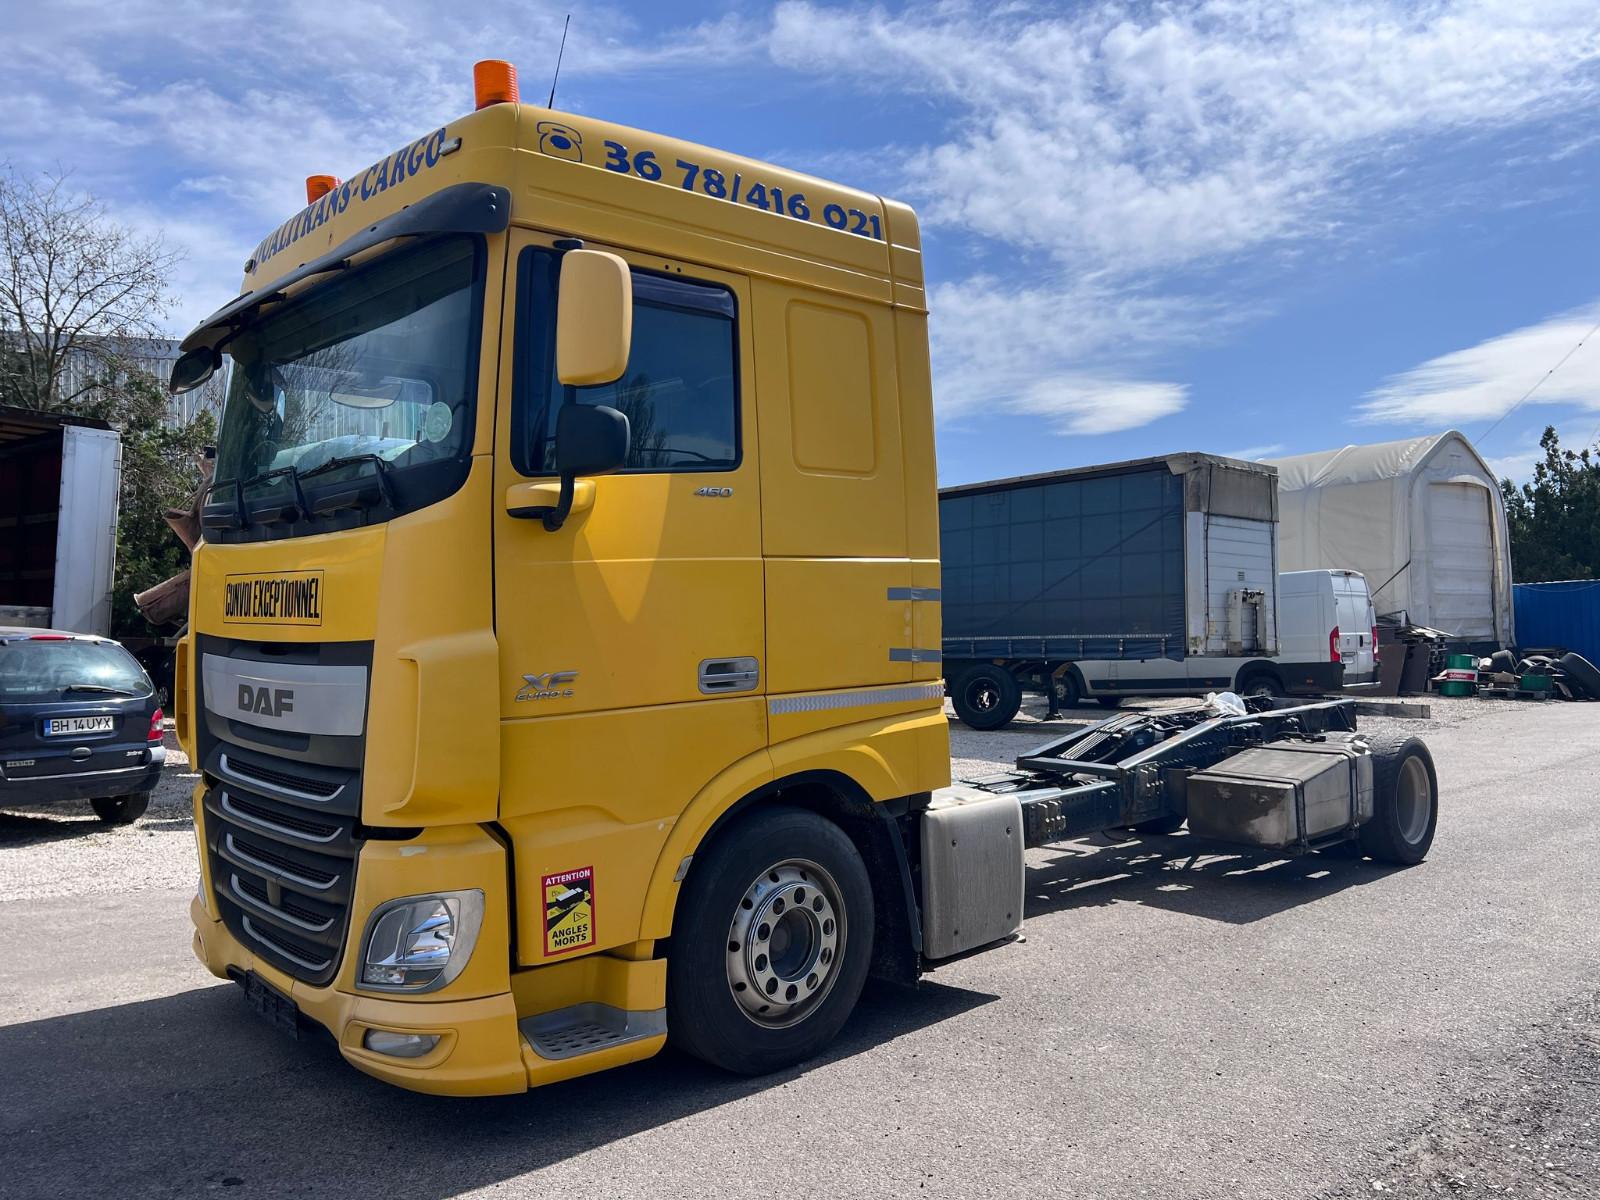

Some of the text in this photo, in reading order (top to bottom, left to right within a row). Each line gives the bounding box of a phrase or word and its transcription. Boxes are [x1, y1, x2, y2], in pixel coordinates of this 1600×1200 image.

[604, 140, 662, 182] 36
[823, 203, 881, 240] 021
[225, 578, 320, 618] CONVOI EXCEPTIONNEL
[519, 671, 577, 690] XF
[238, 684, 294, 717] DAF
[51, 718, 111, 732] BH 14 UYX
[545, 869, 591, 886] ATTENTION
[552, 923, 588, 939] ANGLES
[554, 933, 587, 948] MORTS
